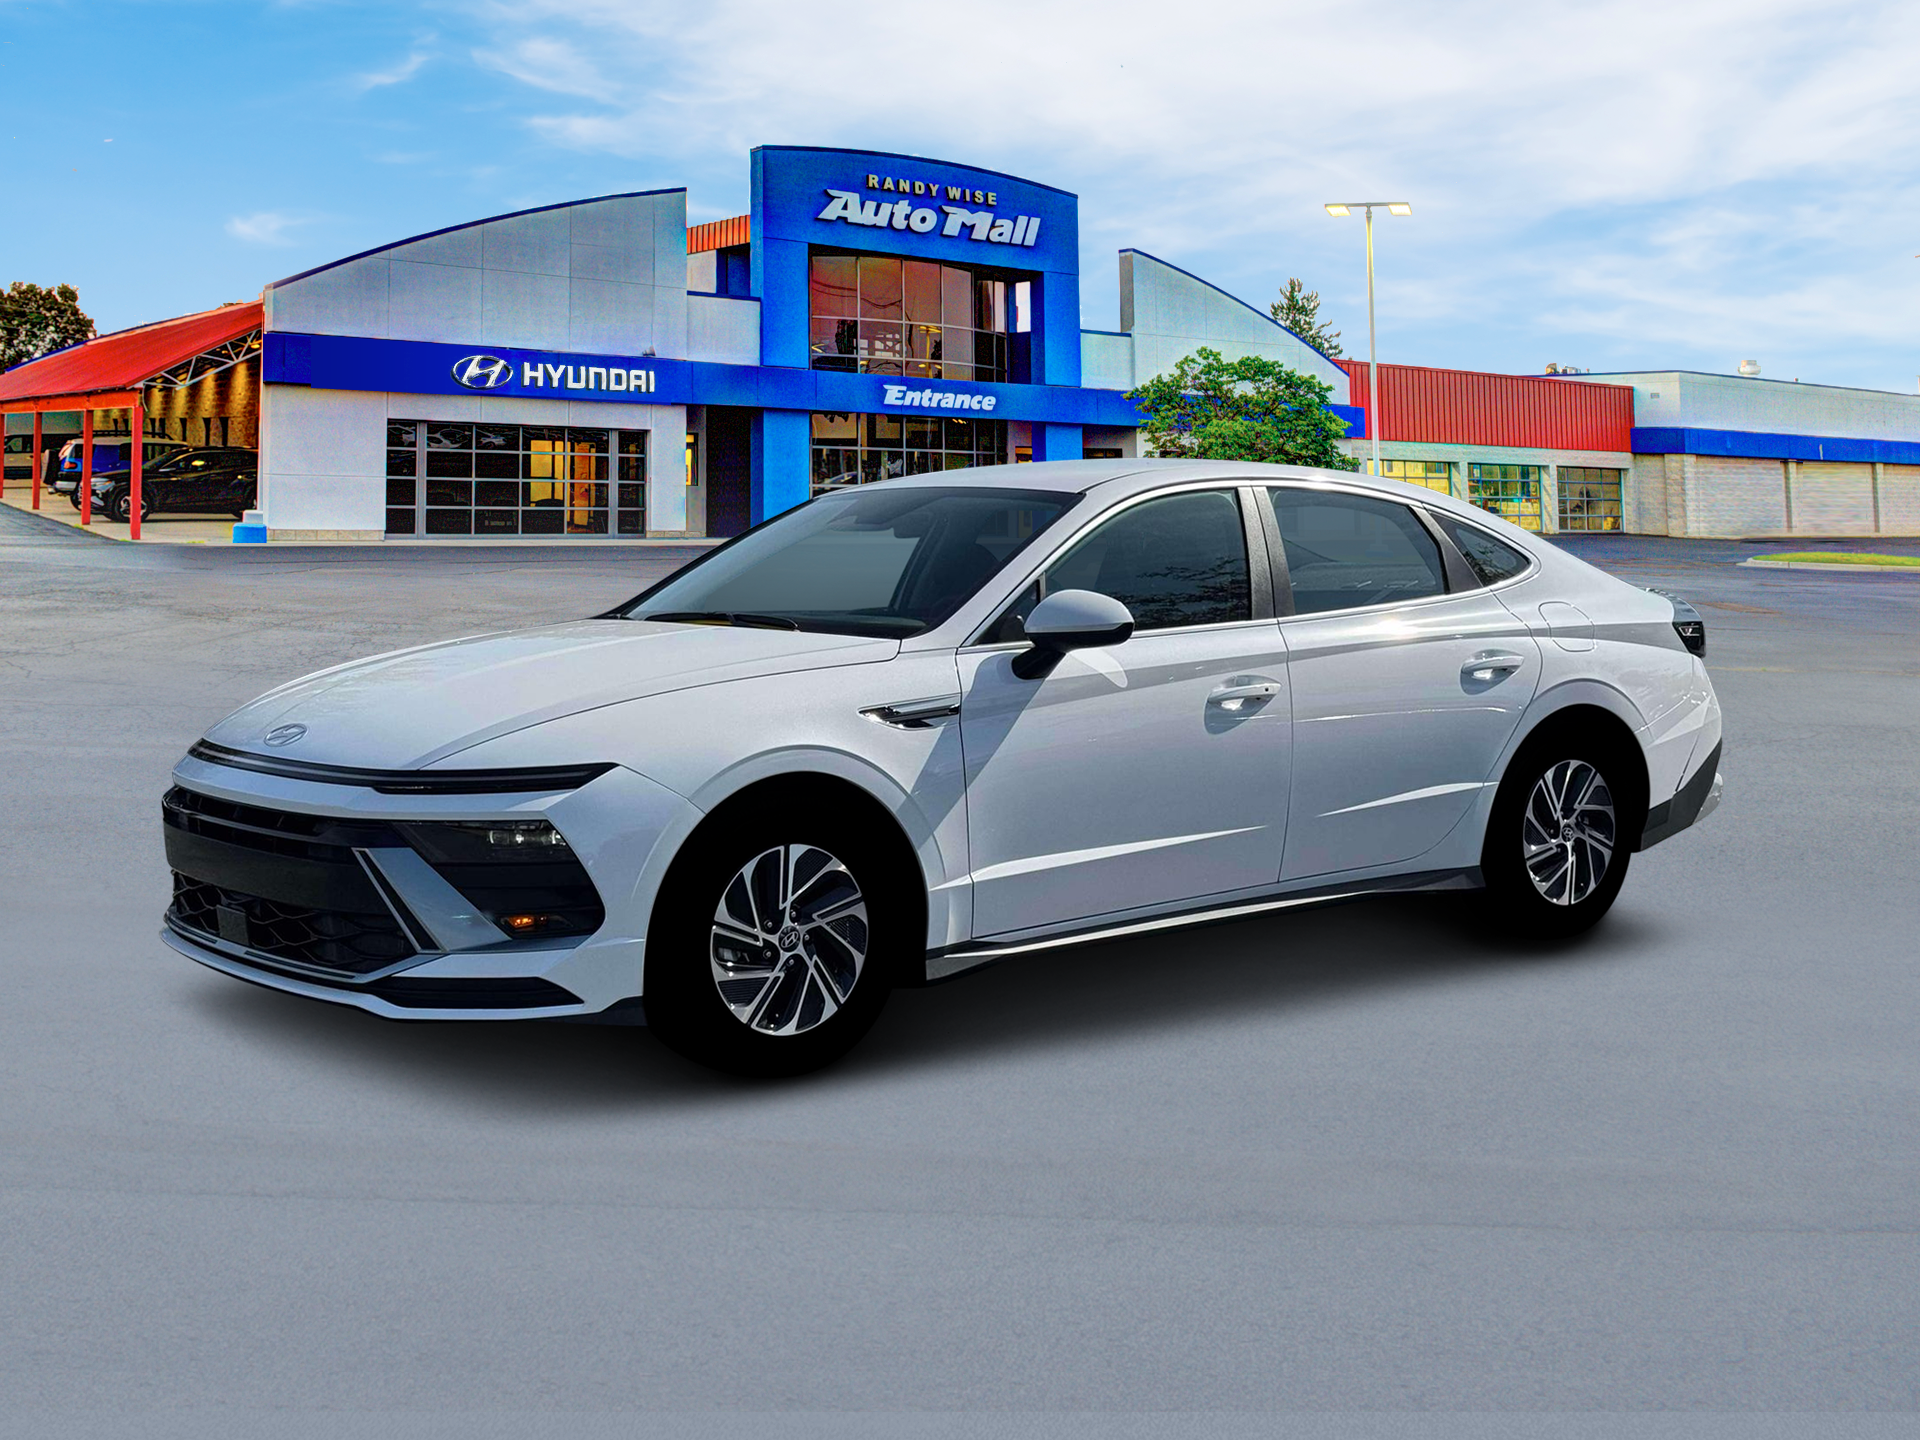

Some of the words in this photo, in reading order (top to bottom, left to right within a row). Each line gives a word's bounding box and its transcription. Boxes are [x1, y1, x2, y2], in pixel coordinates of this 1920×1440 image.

[867, 174, 939, 197] RANDY
[946, 187, 998, 205] WISE
[818, 189, 937, 233] Auto
[942, 206, 1041, 246] Mall
[523, 362, 656, 393] HYUNDAI
[884, 384, 997, 411] Entrance
